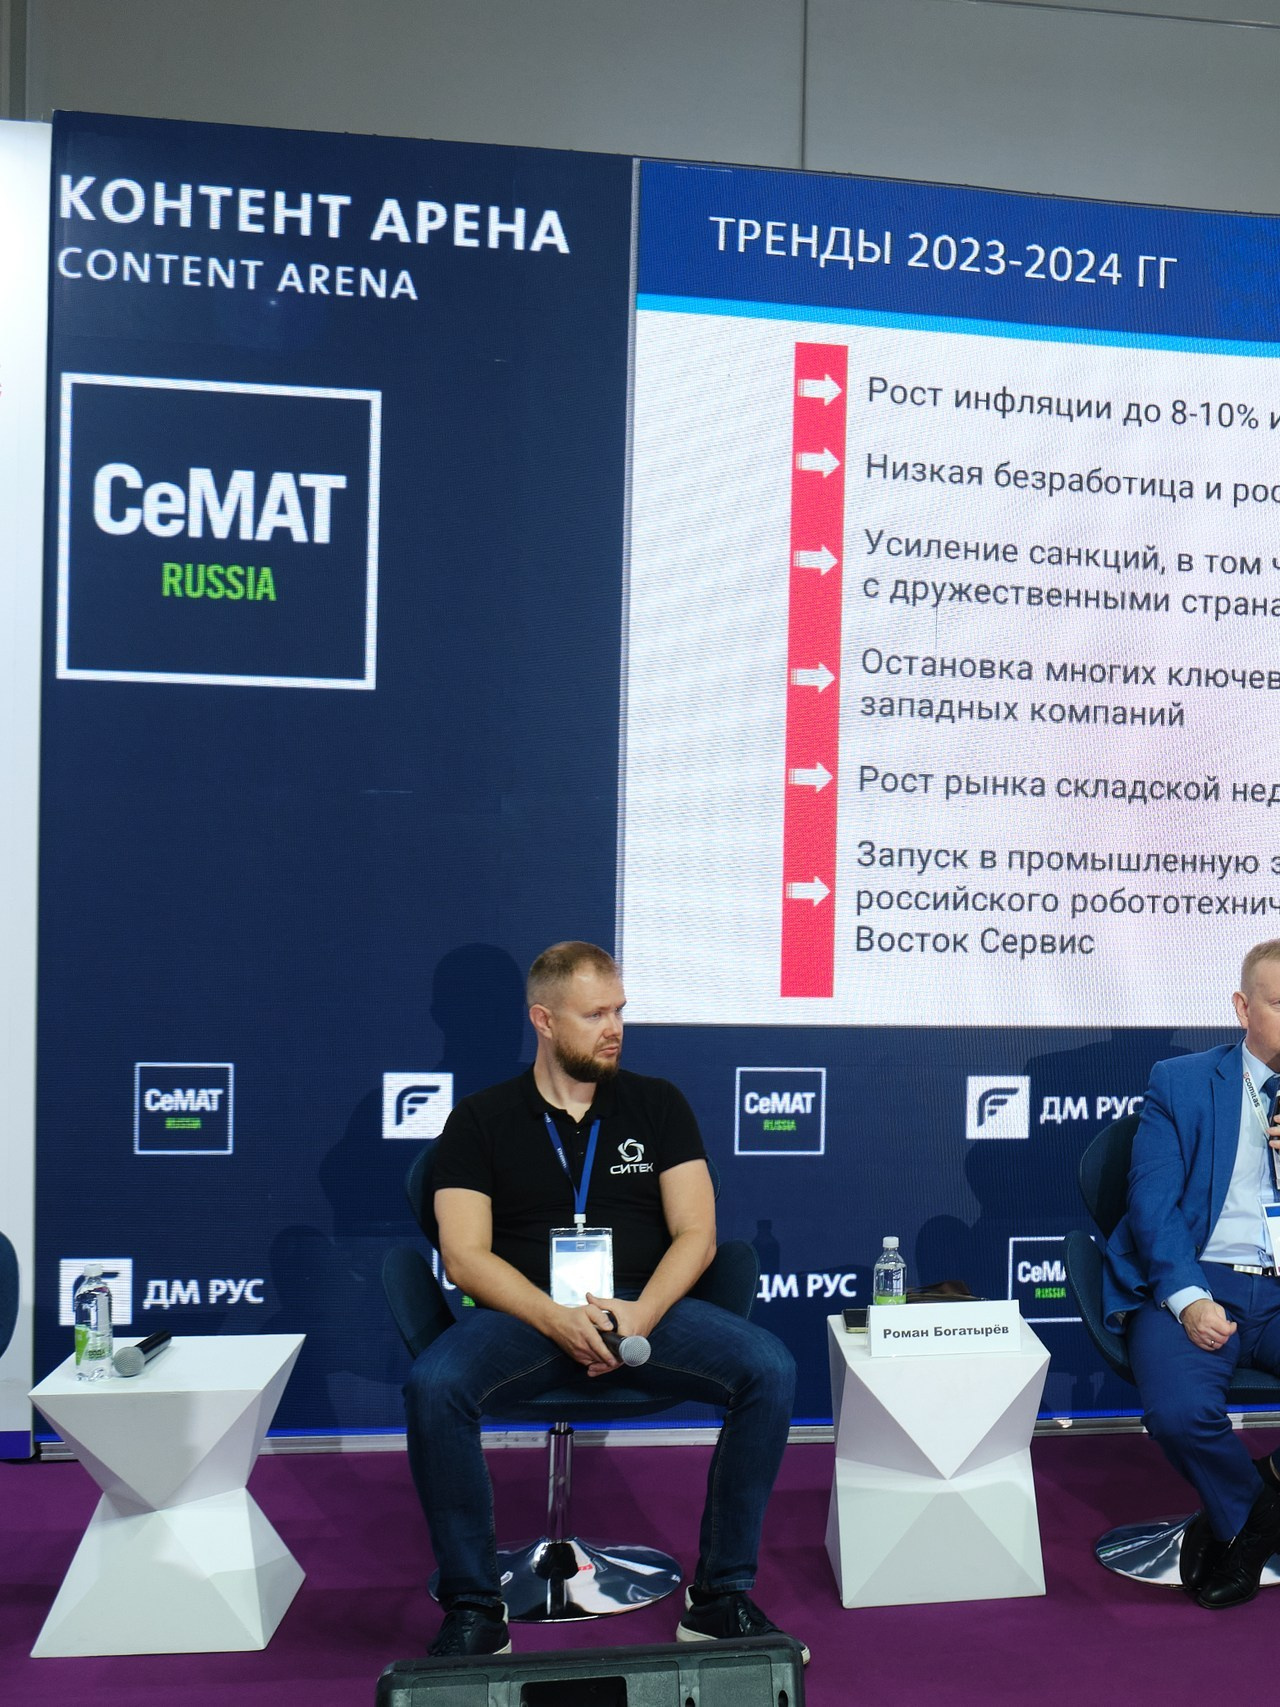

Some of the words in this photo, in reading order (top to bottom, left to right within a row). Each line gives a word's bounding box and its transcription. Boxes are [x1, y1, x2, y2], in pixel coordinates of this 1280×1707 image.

[58, 174, 351, 239] КОНТЕНТ
[370, 199, 571, 254] АРЕНА
[709, 215, 892, 270] ТРЕНДЫ
[907, 231, 1122, 286] 2023-2024
[1136, 255, 1178, 290] ГГ
[57, 246, 264, 292] CONTENT
[277, 263, 418, 301] ARENA
[868, 376, 943, 407] Рост
[954, 385, 1112, 423] инфляции
[1122, 402, 1161, 428] до
[1171, 399, 1259, 430] 8-10%
[866, 452, 983, 486] Низкая
[994, 460, 1194, 504] безработица
[1205, 481, 1222, 500] и
[93, 462, 347, 544] CeMAT
[864, 528, 1019, 563] Усиление
[1029, 544, 1166, 576] санкций,
[1177, 553, 1194, 572] в
[1204, 554, 1262, 576] том
[162, 562, 277, 601] RUSSIA
[863, 577, 880, 599] с
[889, 579, 1170, 612] дружественными
[861, 647, 1033, 681] Остановка
[1046, 661, 1156, 685] многих
[860, 696, 1018, 724] западных
[1030, 701, 1185, 727] компаний
[859, 765, 934, 794] Рост
[945, 774, 1046, 801] рынка
[1055, 775, 1220, 805] складской
[857, 840, 968, 876] Запуск
[980, 849, 997, 870] в
[1008, 850, 1260, 881] промышленную
[856, 885, 1059, 916] российского
[856, 925, 969, 954] Восток
[980, 927, 1095, 961] Сервис
[144, 1088, 224, 1112] CeMAT
[744, 1091, 816, 1114] CeMAT
[1244, 1077, 1261, 1108] comitas
[1040, 1096, 1089, 1125] ДМ
[1096, 1096, 1144, 1120] РУС
[609, 1163, 654, 1175] СИТЕК
[806, 1273, 857, 1298] РУС
[1018, 1260, 1067, 1283] CeM
[142, 1279, 201, 1310] ДМ
[208, 1278, 264, 1304] РУС
[883, 1328, 929, 1339] Роман
[933, 1324, 1010, 1338] Богатырёв
